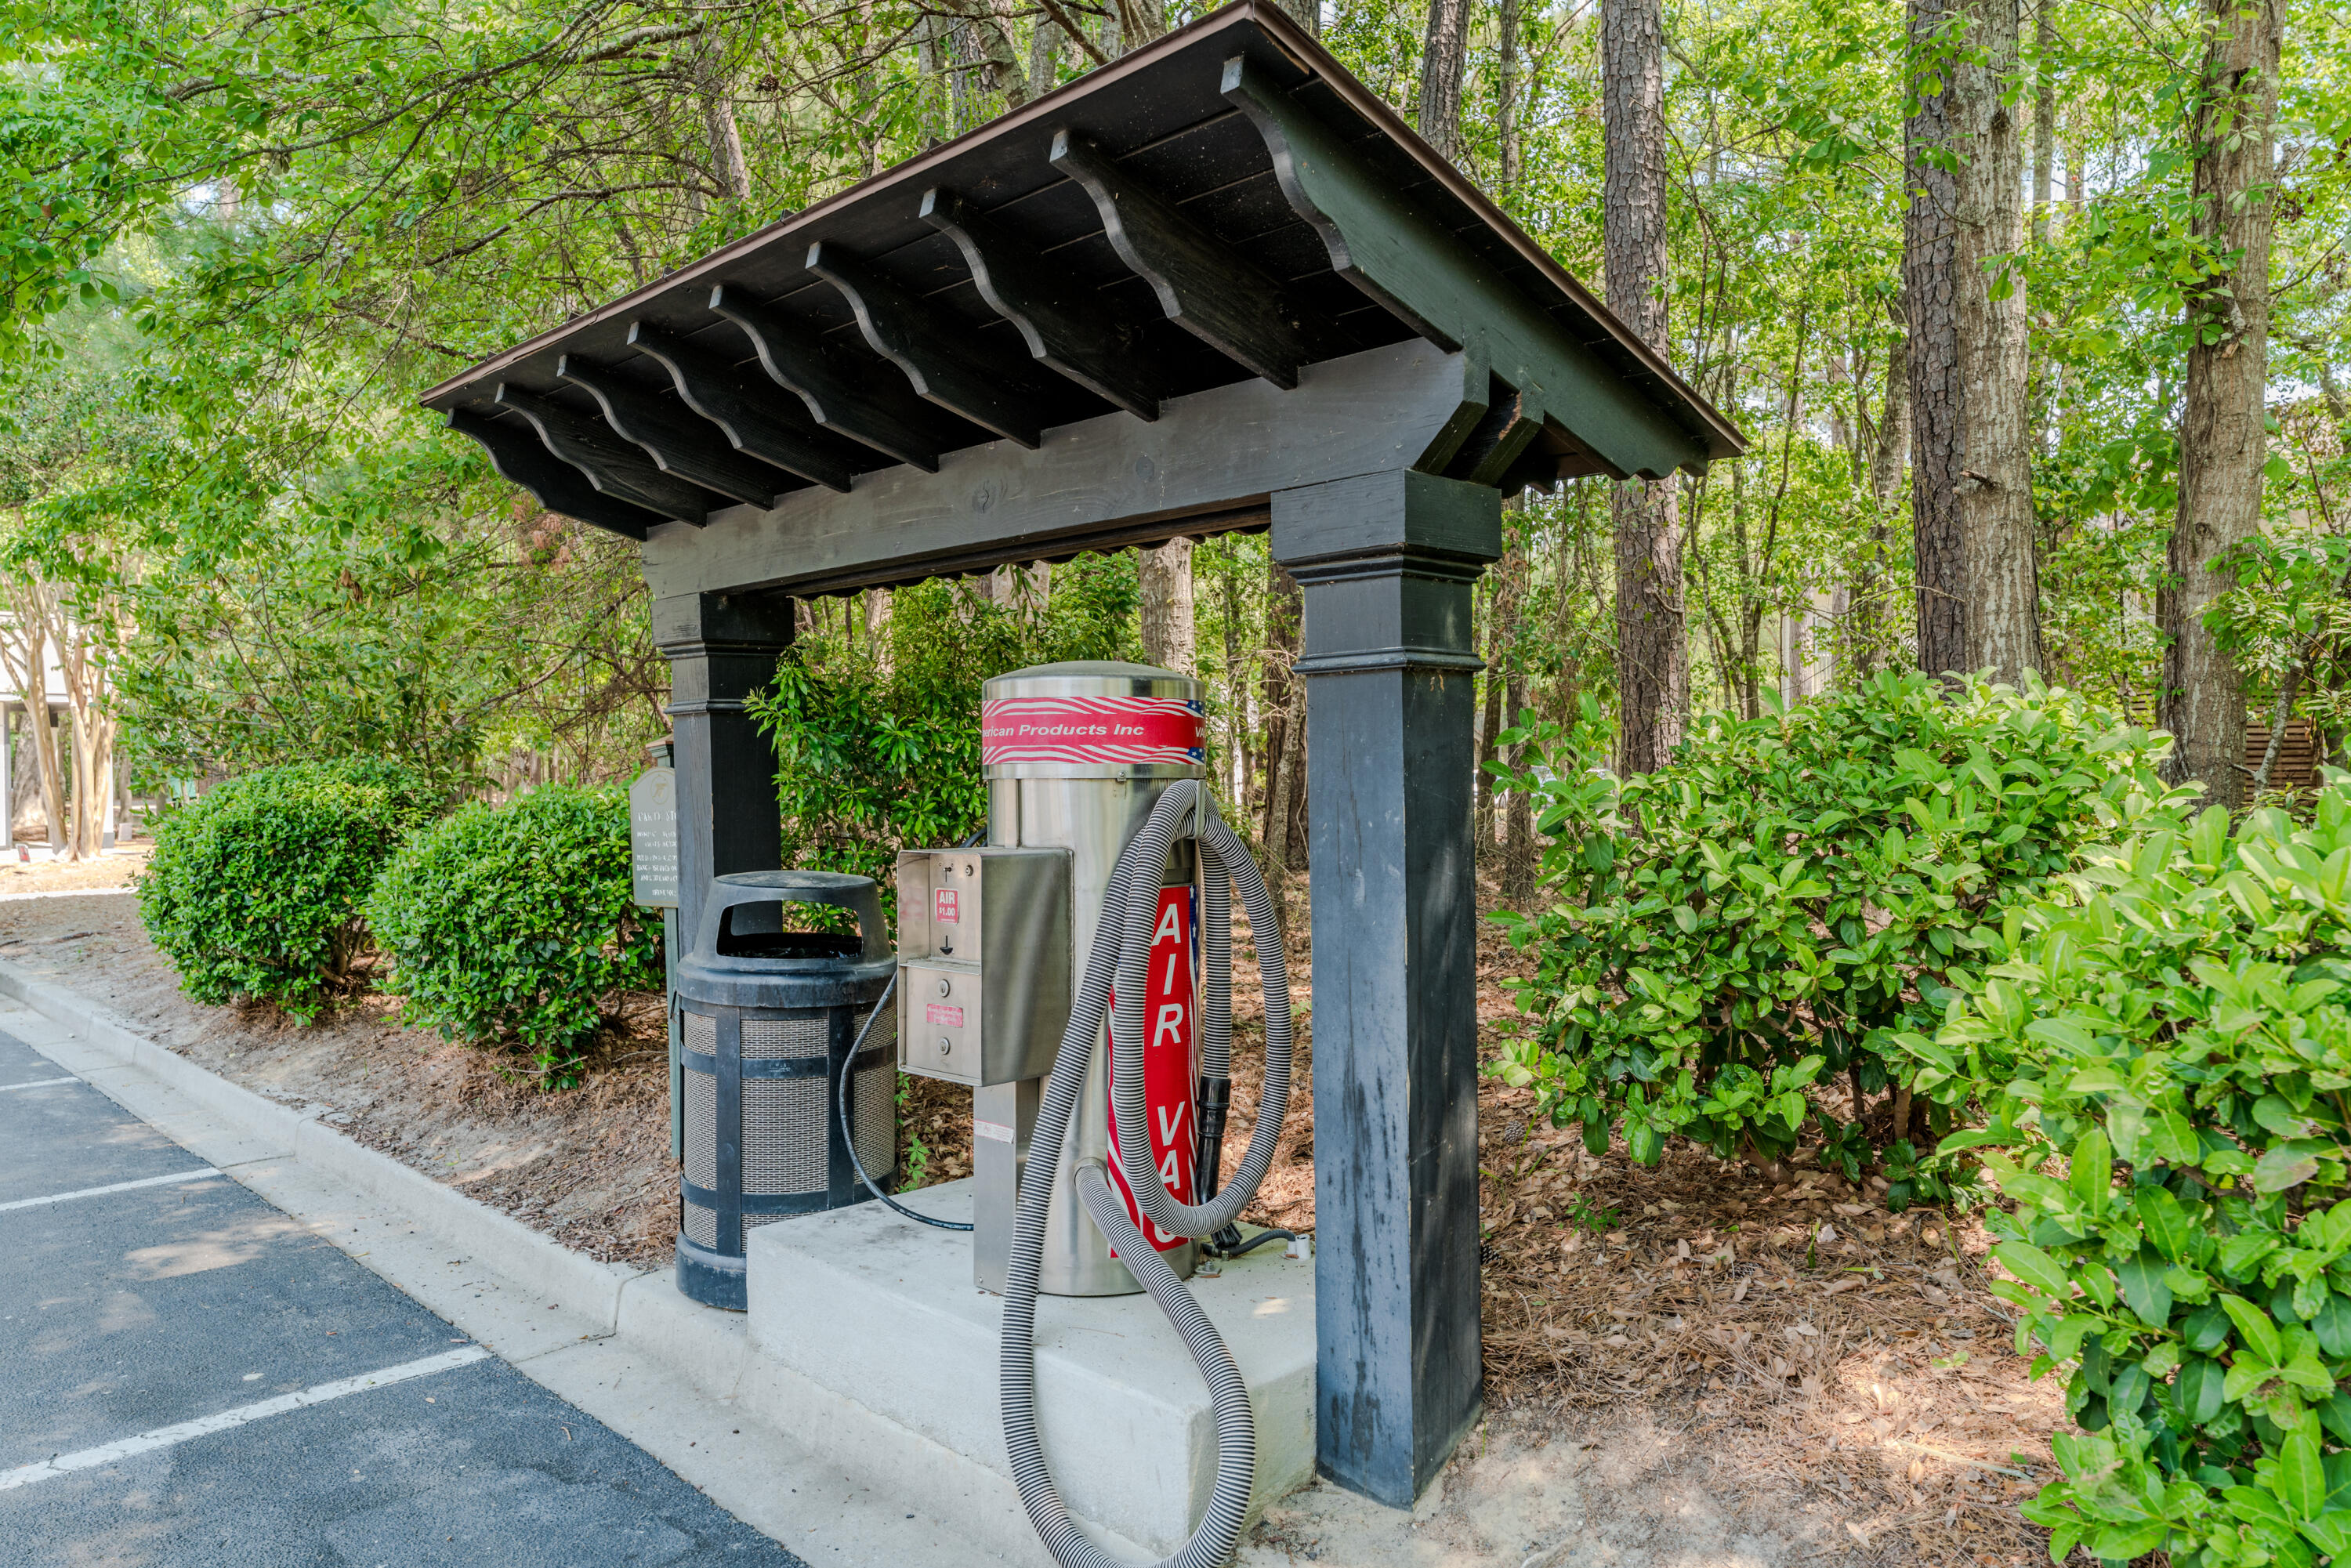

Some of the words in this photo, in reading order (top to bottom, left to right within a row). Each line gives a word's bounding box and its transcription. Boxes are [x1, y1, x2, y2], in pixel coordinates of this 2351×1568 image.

[1019, 723, 1107, 736] Products
[1113, 723, 1144, 736] Inc
[939, 891, 955, 904] AIR
[939, 907, 955, 916] $1.00
[1151, 903, 1183, 1047] AIR
